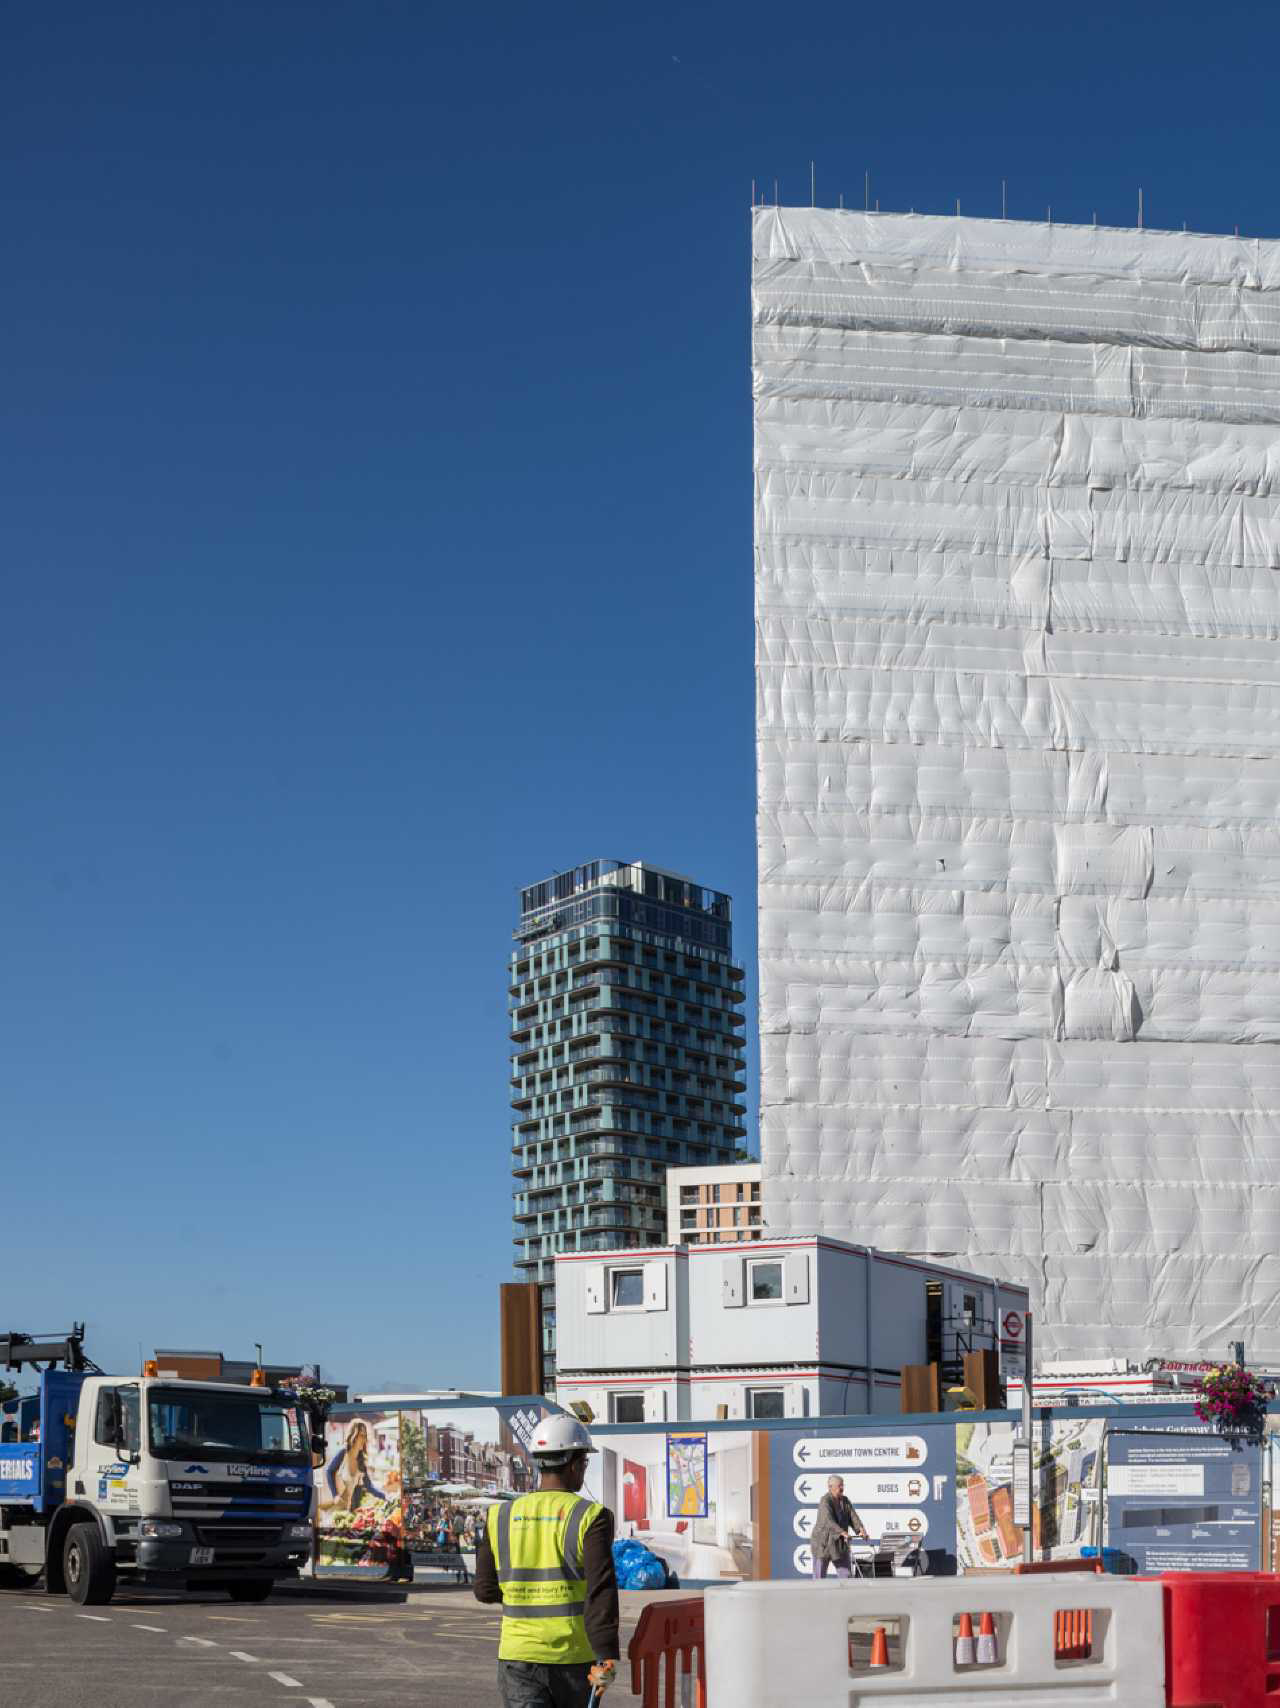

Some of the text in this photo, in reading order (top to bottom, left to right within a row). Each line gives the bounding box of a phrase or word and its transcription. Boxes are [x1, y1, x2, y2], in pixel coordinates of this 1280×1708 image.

[819, 1447, 900, 1458] LEWISHAM TOWN CENTRE
[0, 1459, 33, 1481] ERIALS
[877, 1483, 899, 1493] BUSES
[885, 1521, 900, 1530] DLR
